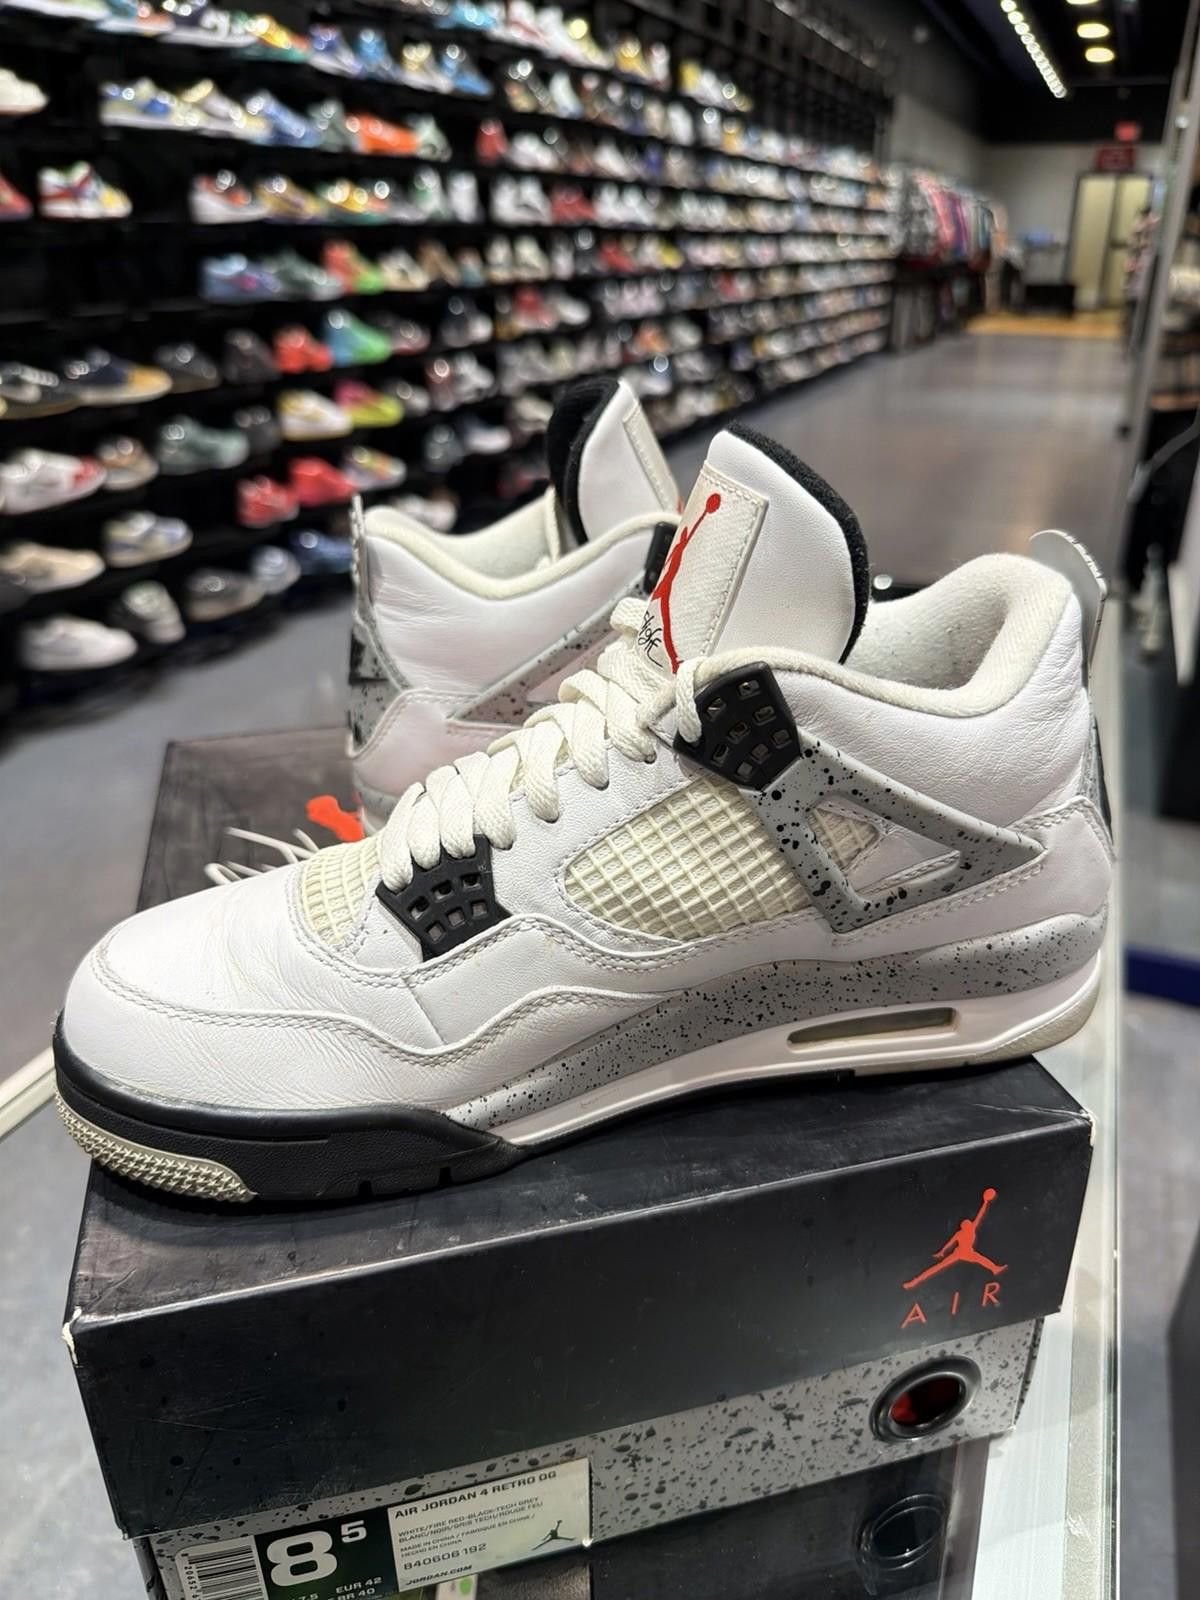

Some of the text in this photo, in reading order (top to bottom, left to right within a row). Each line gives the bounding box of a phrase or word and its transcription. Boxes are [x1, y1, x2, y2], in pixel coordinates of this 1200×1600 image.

[901, 1282, 1000, 1328] AIR
[395, 1470, 557, 1519] AIR JORDAN 4 RETRO OG
[398, 1521, 447, 1537] WHITE/FIRE
[518, 1496, 539, 1506] GREY
[266, 1520, 367, 1587] 8 5
[400, 1543, 422, 1552] MADE
[432, 1534, 455, 1545] CHINA
[335, 1581, 362, 1594] EUR
[365, 1576, 382, 1586] 42
[405, 1564, 472, 1586] JORDAN.COM
[358, 1587, 375, 1597] 40
